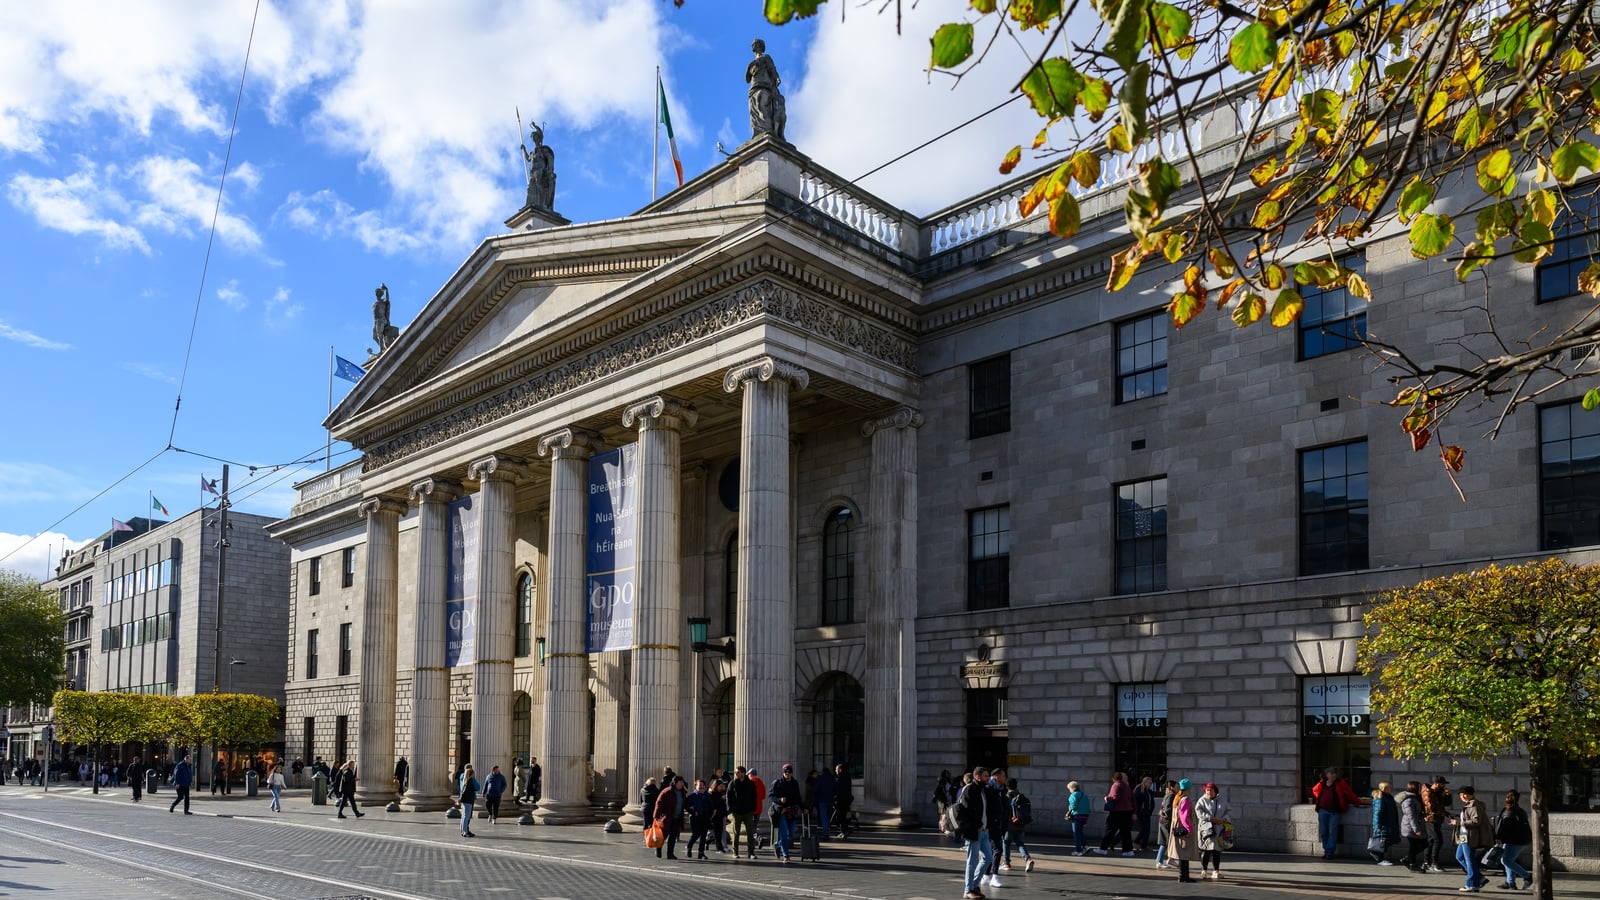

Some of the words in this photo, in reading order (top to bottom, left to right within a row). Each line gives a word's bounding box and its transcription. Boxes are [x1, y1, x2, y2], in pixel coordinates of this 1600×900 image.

[595, 505, 633, 524] Nua-Stair
[611, 526, 621, 536] na
[596, 538, 633, 553] hÉireann
[591, 581, 634, 618] GPO
[590, 617, 633, 632] museum
[1123, 691, 1146, 702] GPO
[1311, 684, 1338, 697] GPO
[1314, 711, 1362, 728] Shop
